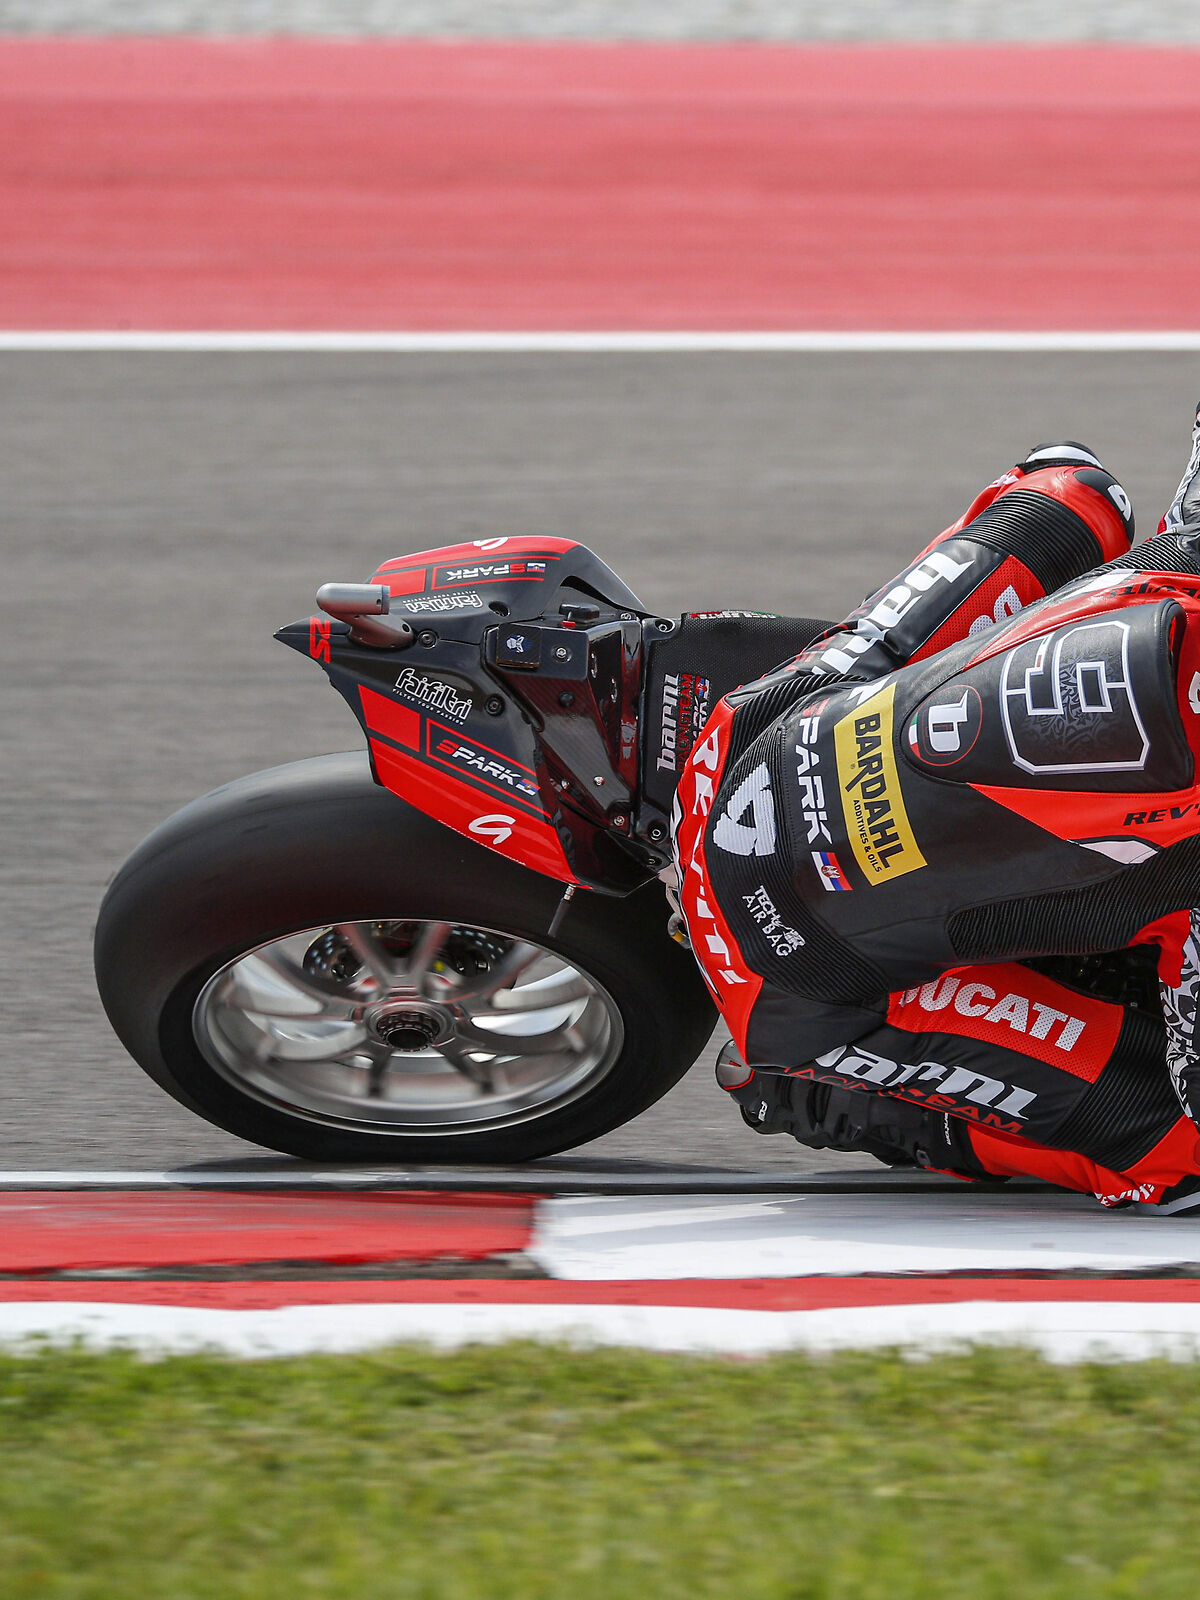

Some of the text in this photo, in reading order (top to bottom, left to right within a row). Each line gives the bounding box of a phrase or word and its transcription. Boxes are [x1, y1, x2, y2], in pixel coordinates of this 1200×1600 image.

[446, 563, 526, 581] SPARK
[657, 673, 679, 771] barni
[1000, 619, 1151, 776] 9
[436, 739, 522, 786] SPARK
[845, 713, 904, 869] BARDAHL
[853, 799, 869, 844] ADDITIVES
[867, 852, 883, 873] OILS
[742, 893, 793, 958] AIR BAG
